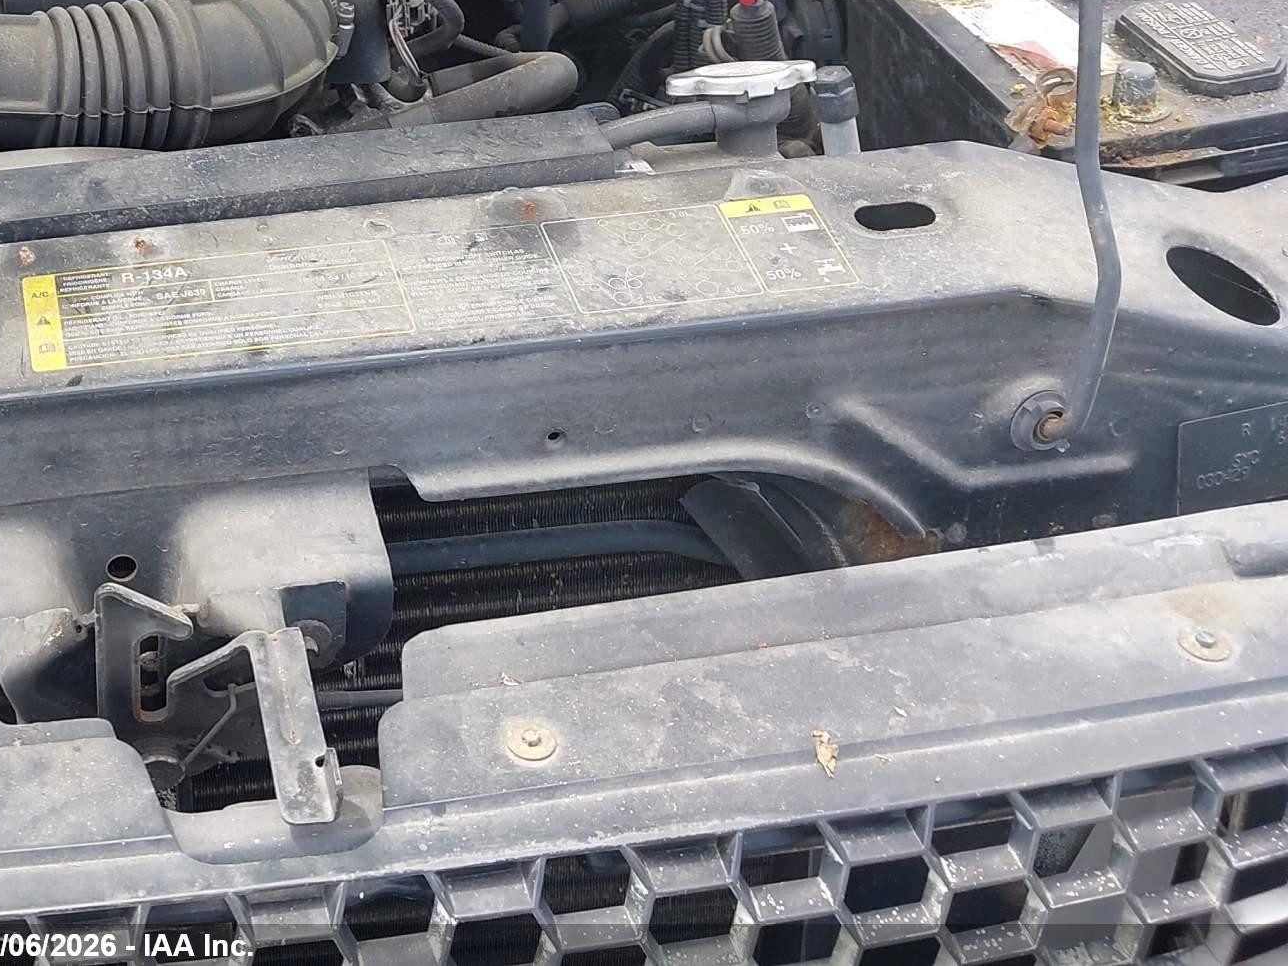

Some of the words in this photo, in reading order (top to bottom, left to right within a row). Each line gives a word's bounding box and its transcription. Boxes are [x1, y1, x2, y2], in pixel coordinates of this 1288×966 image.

[740, 223, 776, 235] 50%
[121, 267, 189, 284] R-134A
[765, 268, 803, 281] 50%
[31, 291, 50, 299] A/C
[156, 291, 180, 300] SAE
